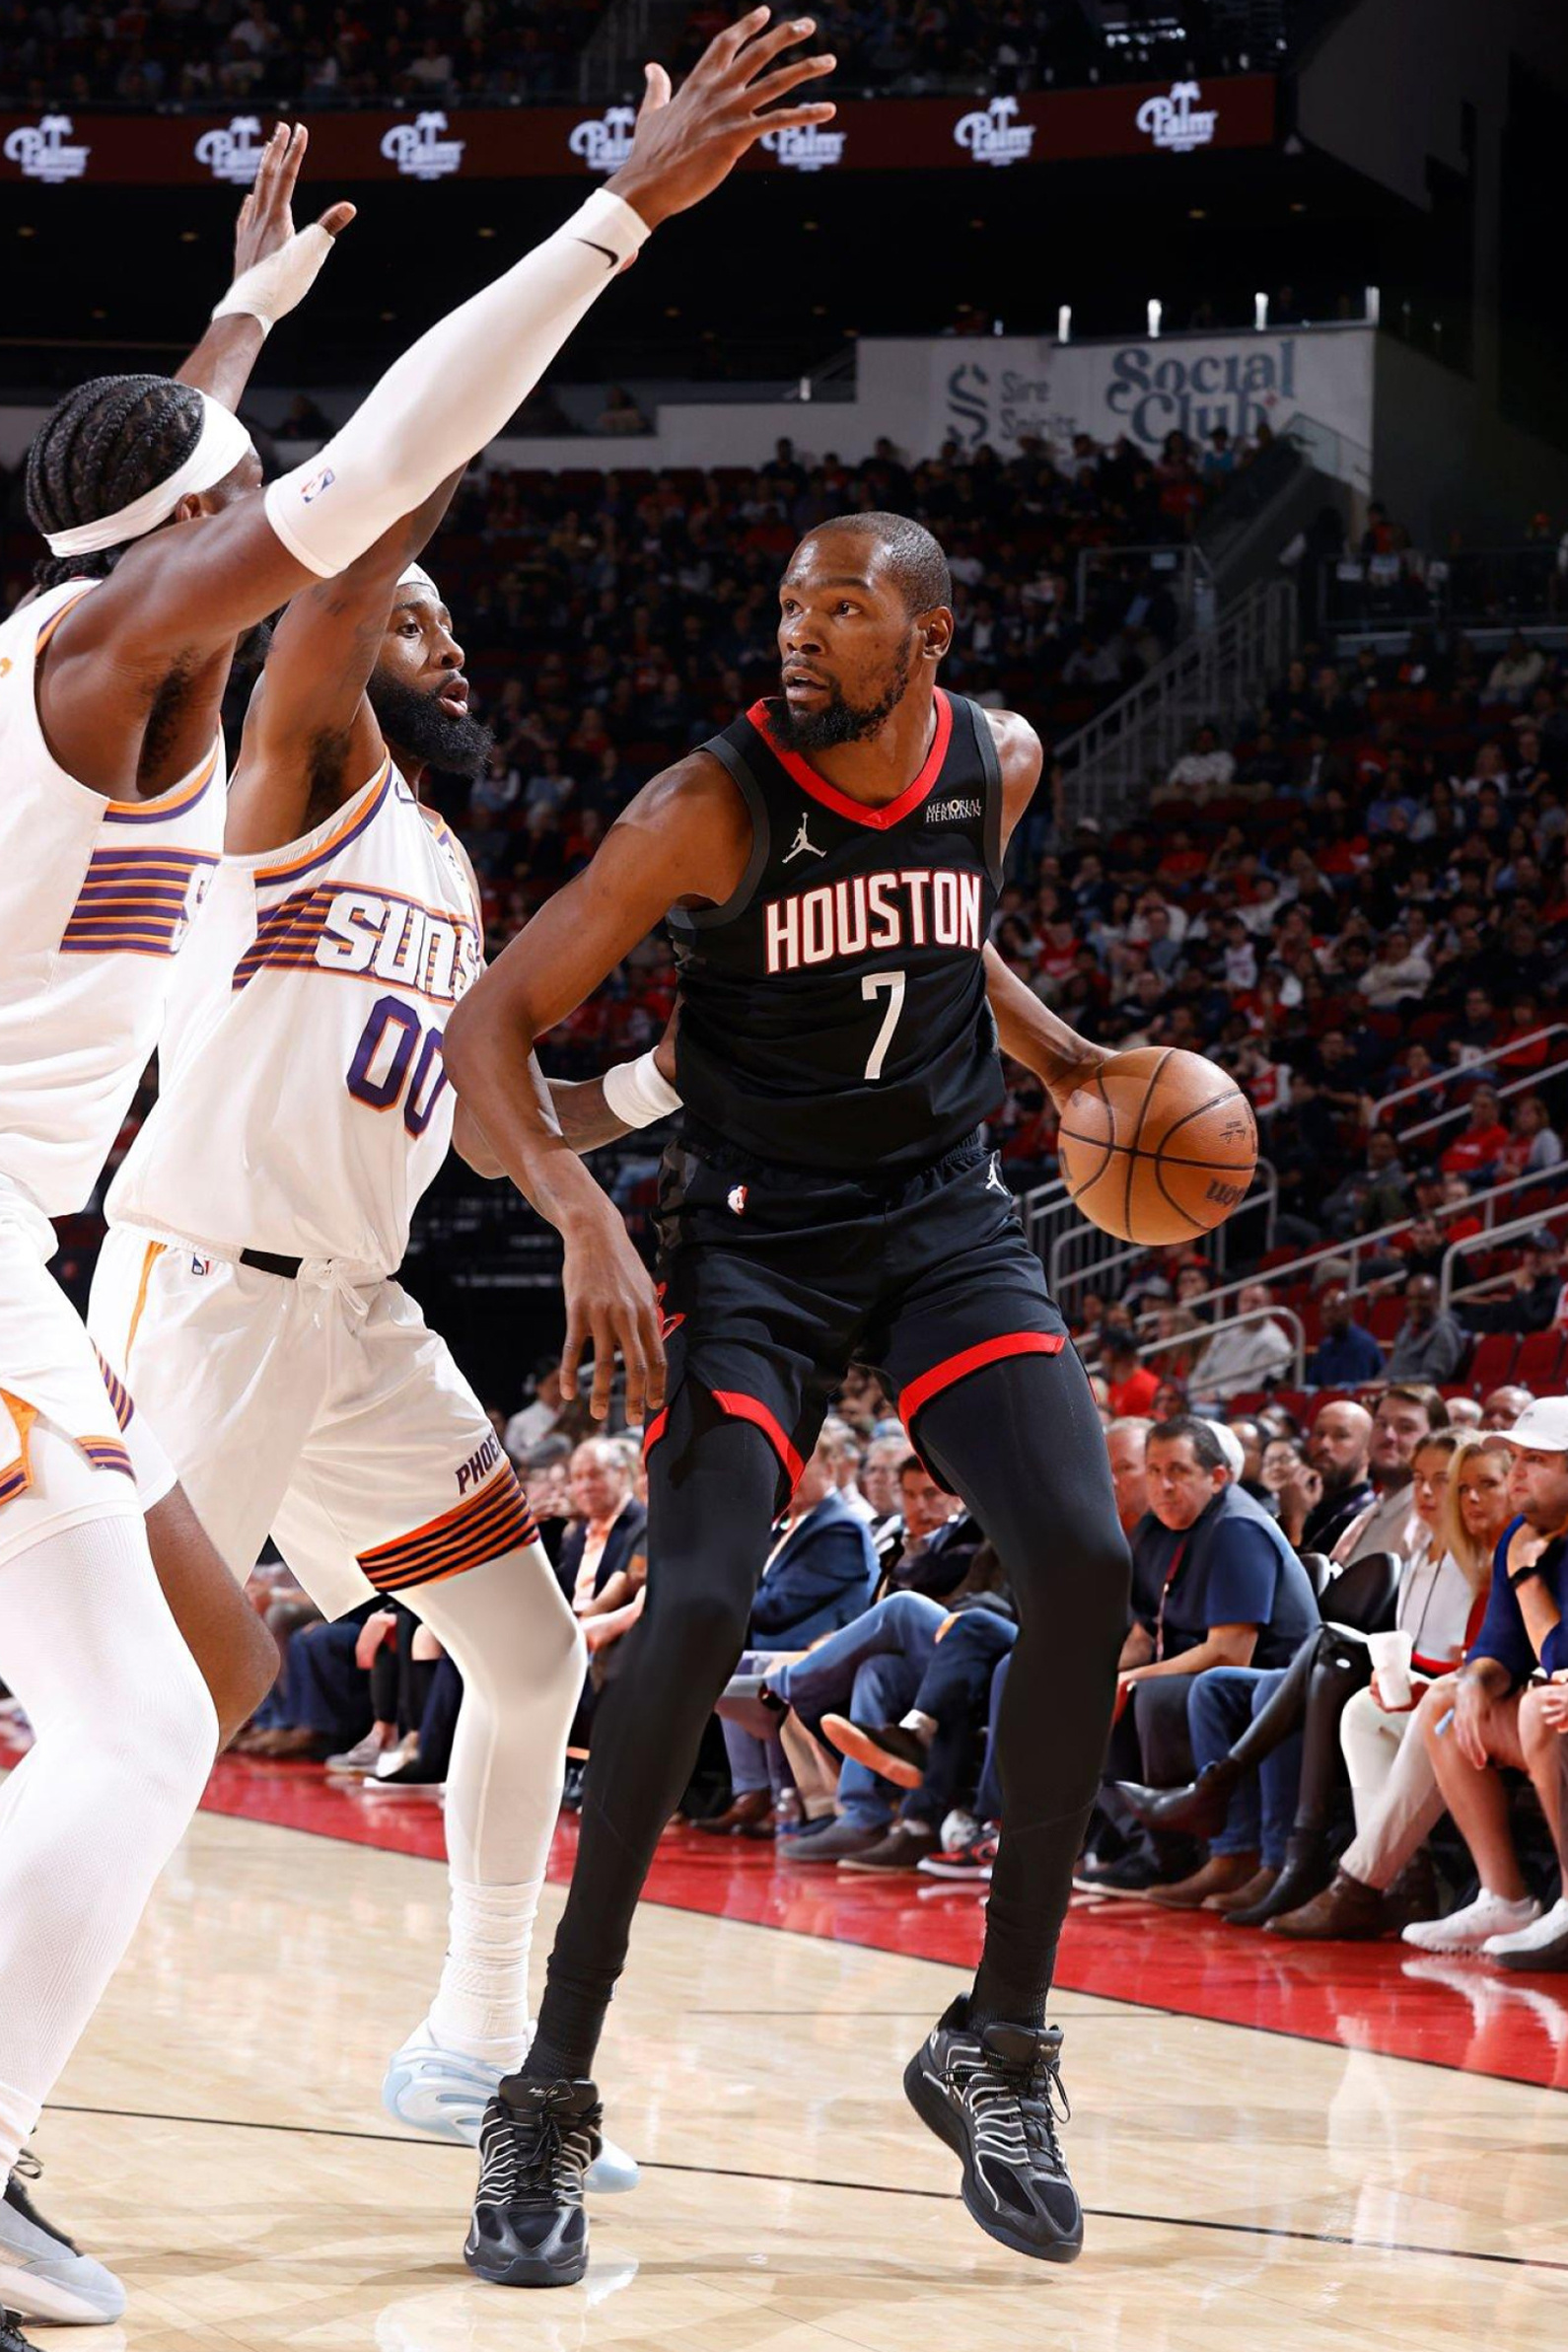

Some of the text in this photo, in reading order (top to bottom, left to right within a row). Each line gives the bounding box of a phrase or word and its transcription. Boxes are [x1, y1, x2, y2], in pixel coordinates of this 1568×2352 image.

[1106, 341, 1296, 413] Social
[1131, 391, 1270, 444] Club
[926, 805, 981, 823] HERMANN
[927, 798, 982, 816] MEMORIAL
[314, 891, 480, 1003] SUNS
[764, 868, 984, 975] HOUSTON
[861, 969, 906, 1080] 7
[346, 995, 450, 1141] 00
[455, 1428, 501, 1497] PHOE
